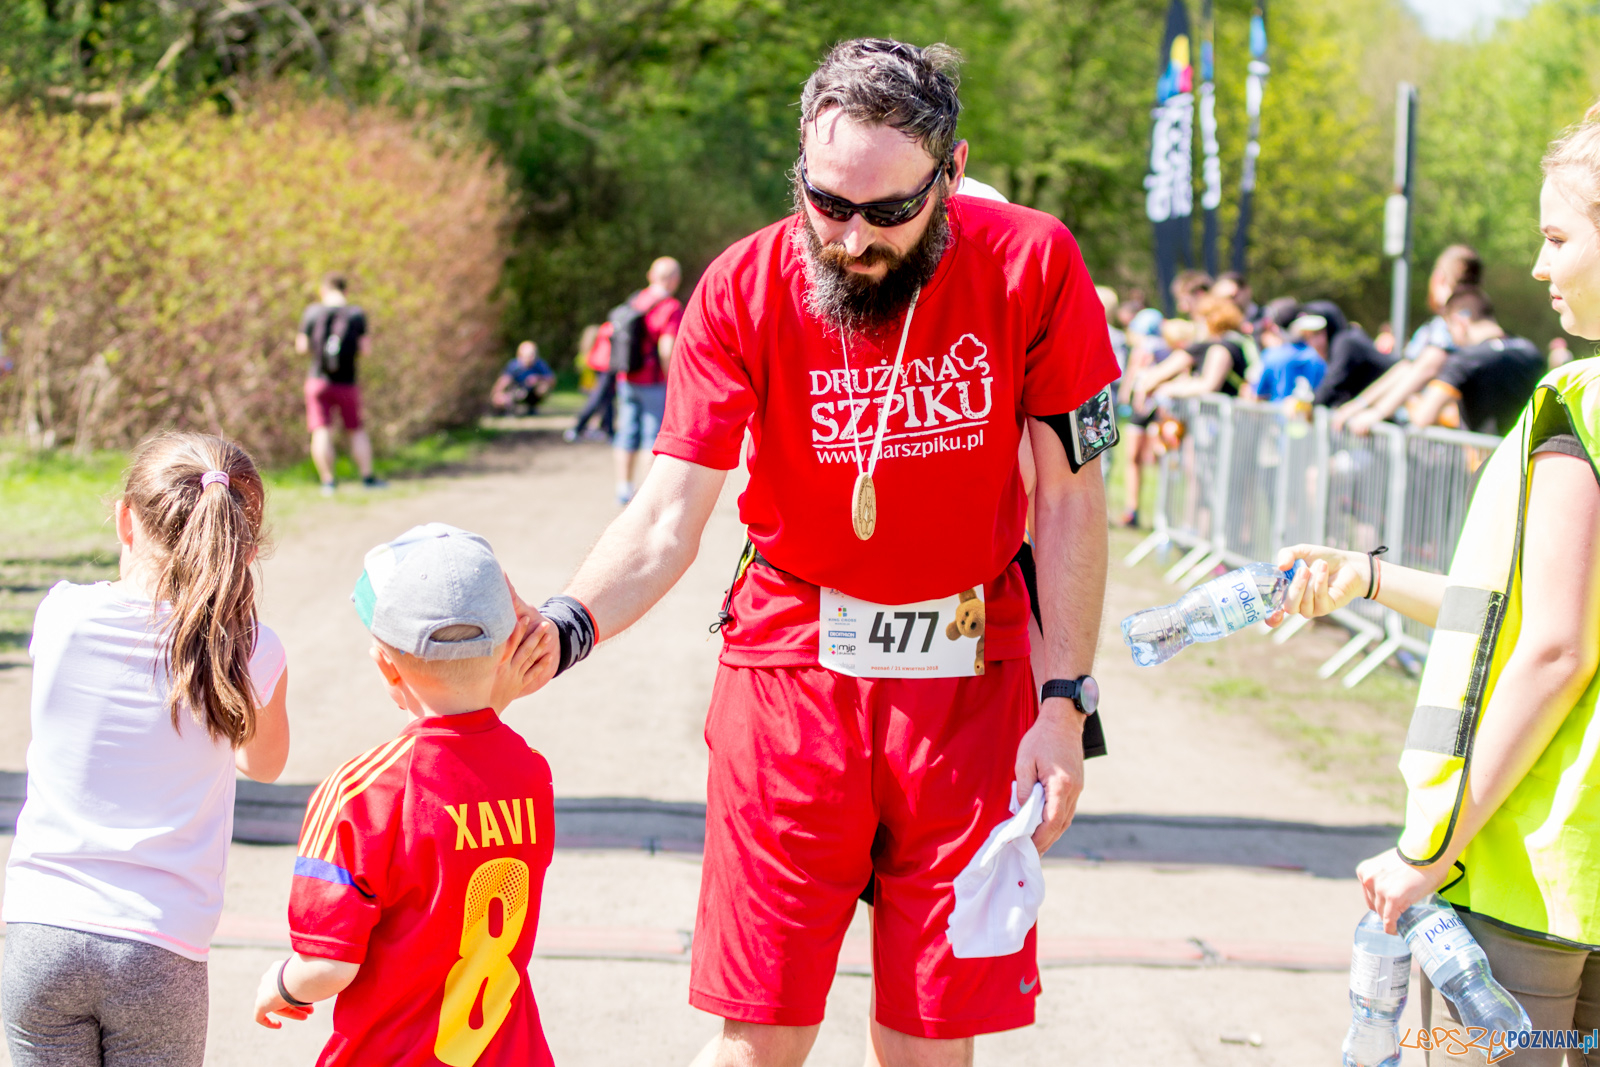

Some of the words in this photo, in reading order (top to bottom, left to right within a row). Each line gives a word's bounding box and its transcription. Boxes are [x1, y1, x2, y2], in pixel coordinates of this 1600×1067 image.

[809, 354, 960, 395] DRUŻYNA
[811, 377, 993, 442] SZPIKU
[1231, 582, 1260, 623] polaris
[838, 644, 856, 653] mjp
[868, 611, 939, 653] 477
[443, 797, 537, 851] XAVI
[434, 857, 530, 1067] 8
